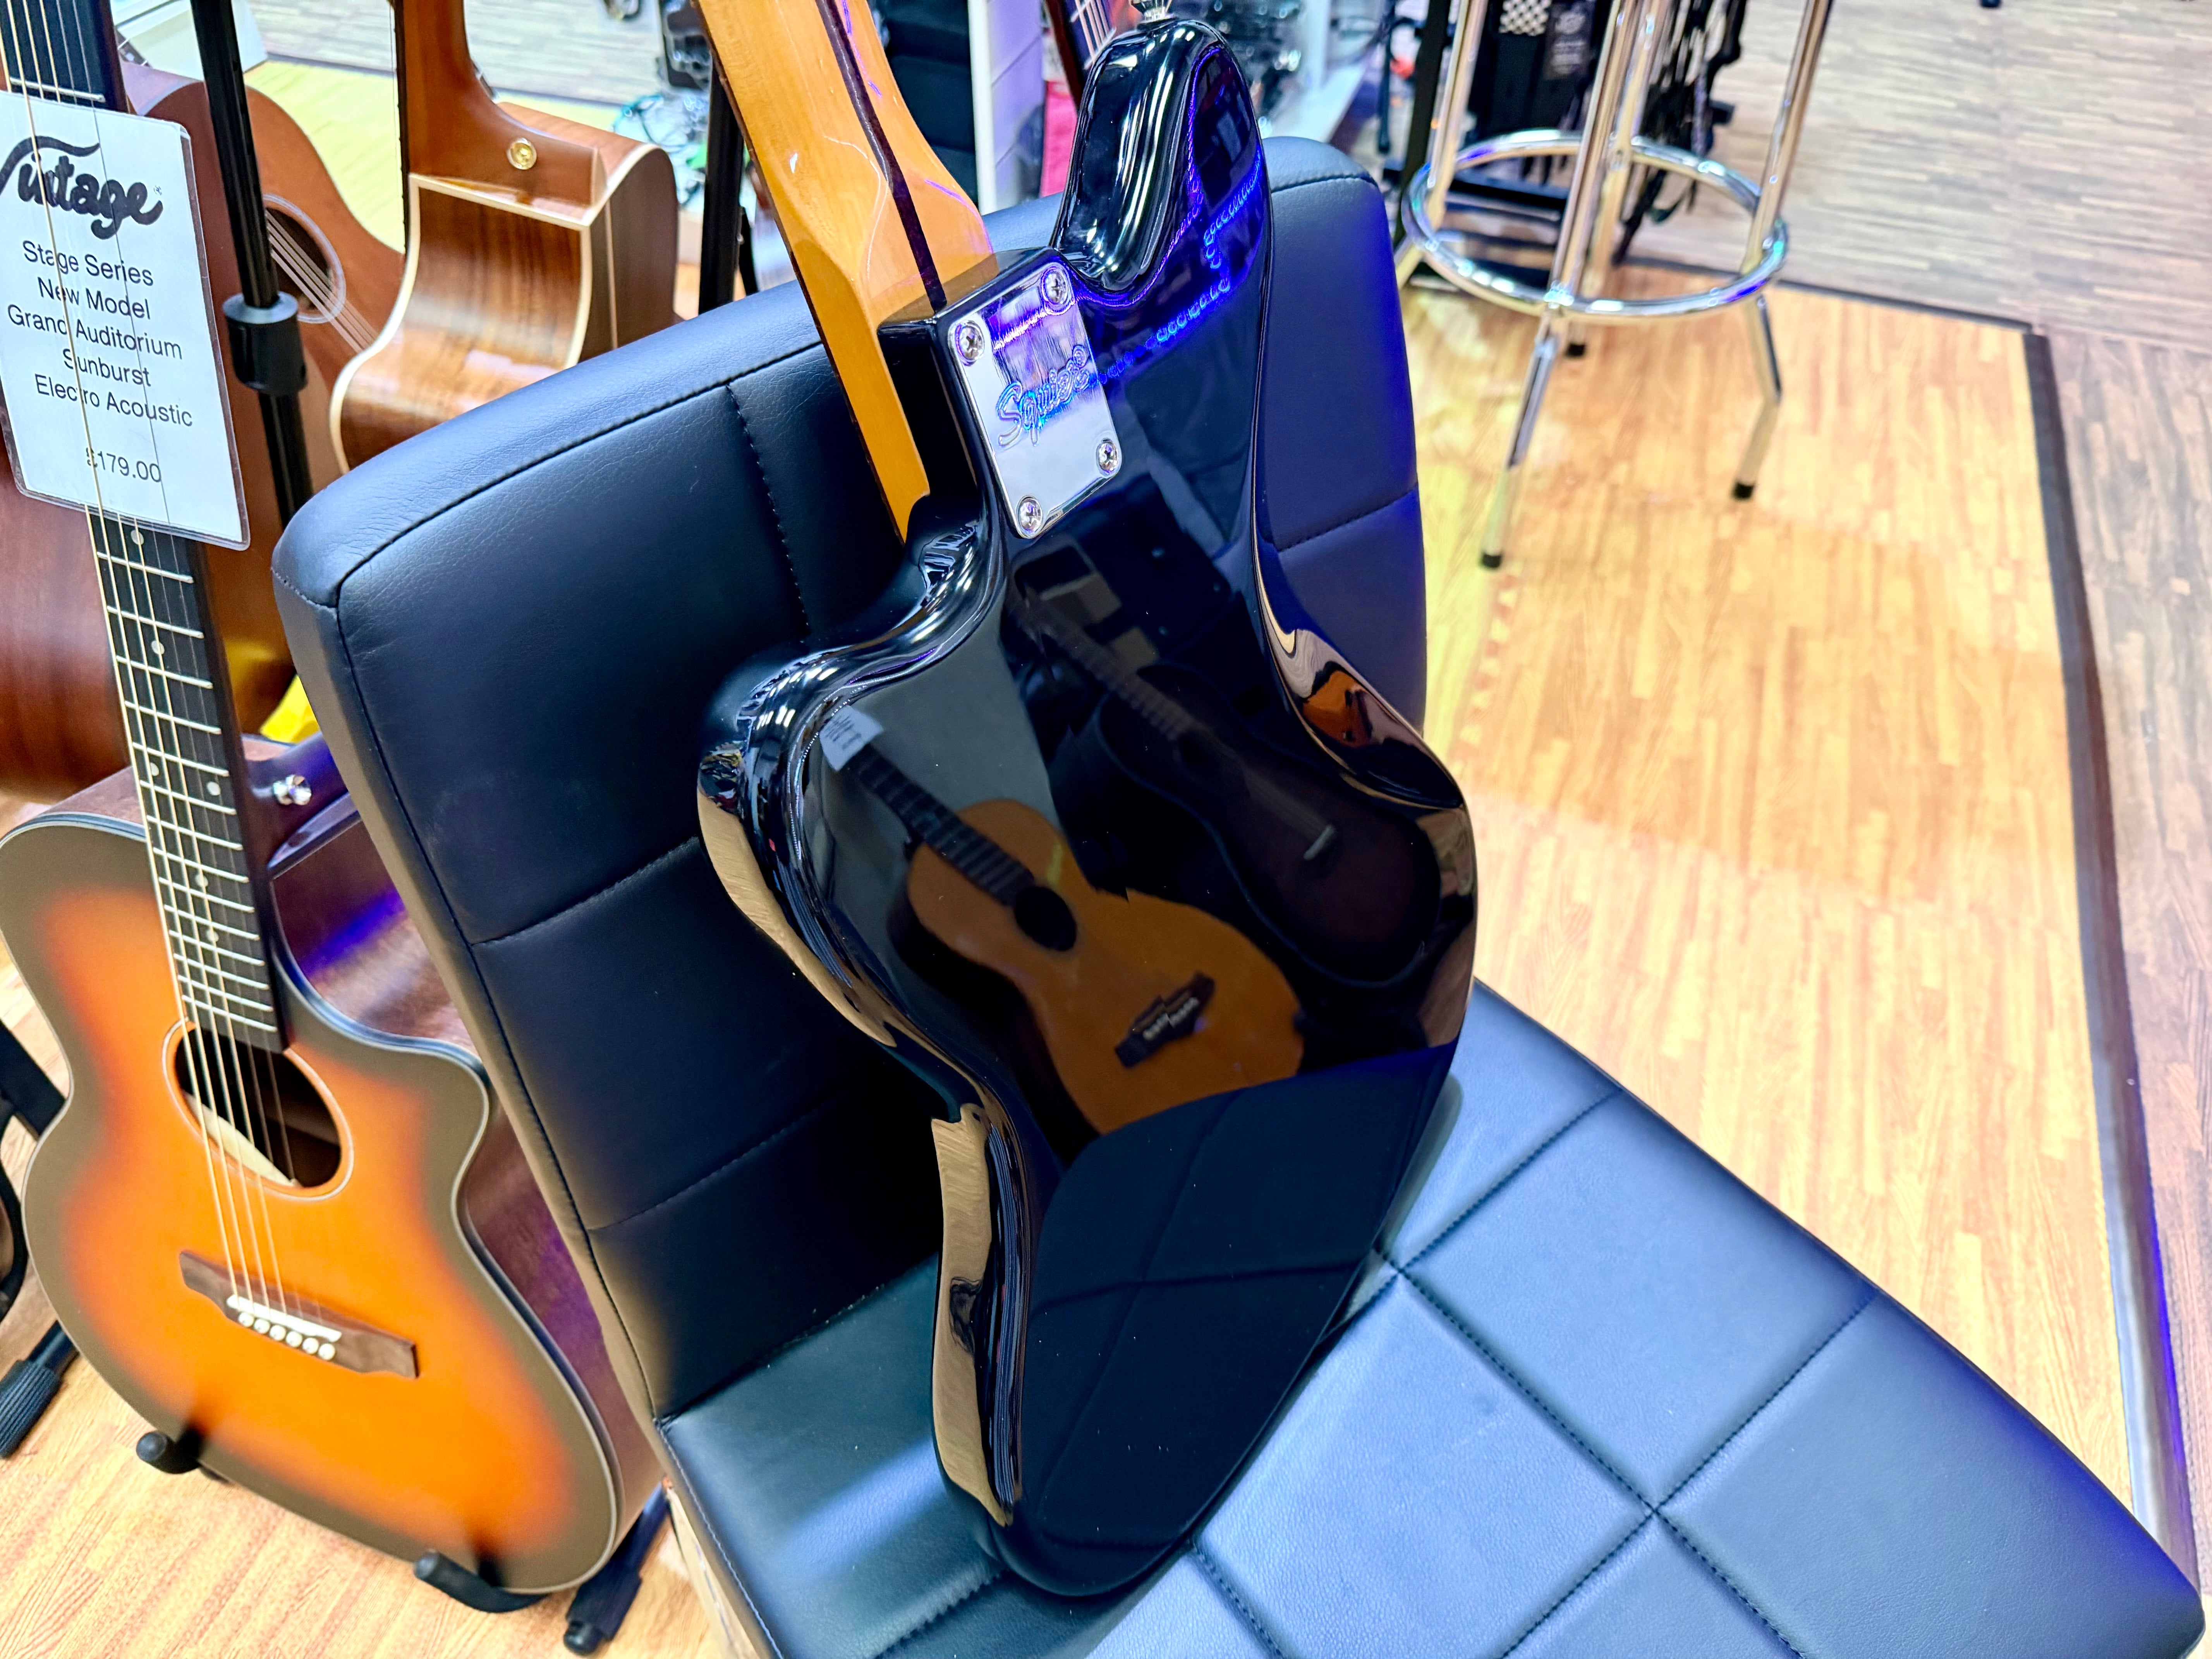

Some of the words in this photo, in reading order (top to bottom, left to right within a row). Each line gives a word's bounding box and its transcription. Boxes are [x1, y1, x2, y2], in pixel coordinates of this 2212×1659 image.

[23, 240, 79, 274] Stage
[85, 254, 154, 286] Series
[38, 276, 79, 305] New
[86, 288, 151, 319] Model
[76, 319, 182, 360] Auditorium
[63, 349, 151, 387] Sunburst
[34, 374, 100, 407] Elecro
[107, 392, 193, 427] Acoustic
[997, 345, 1089, 446] Squier
